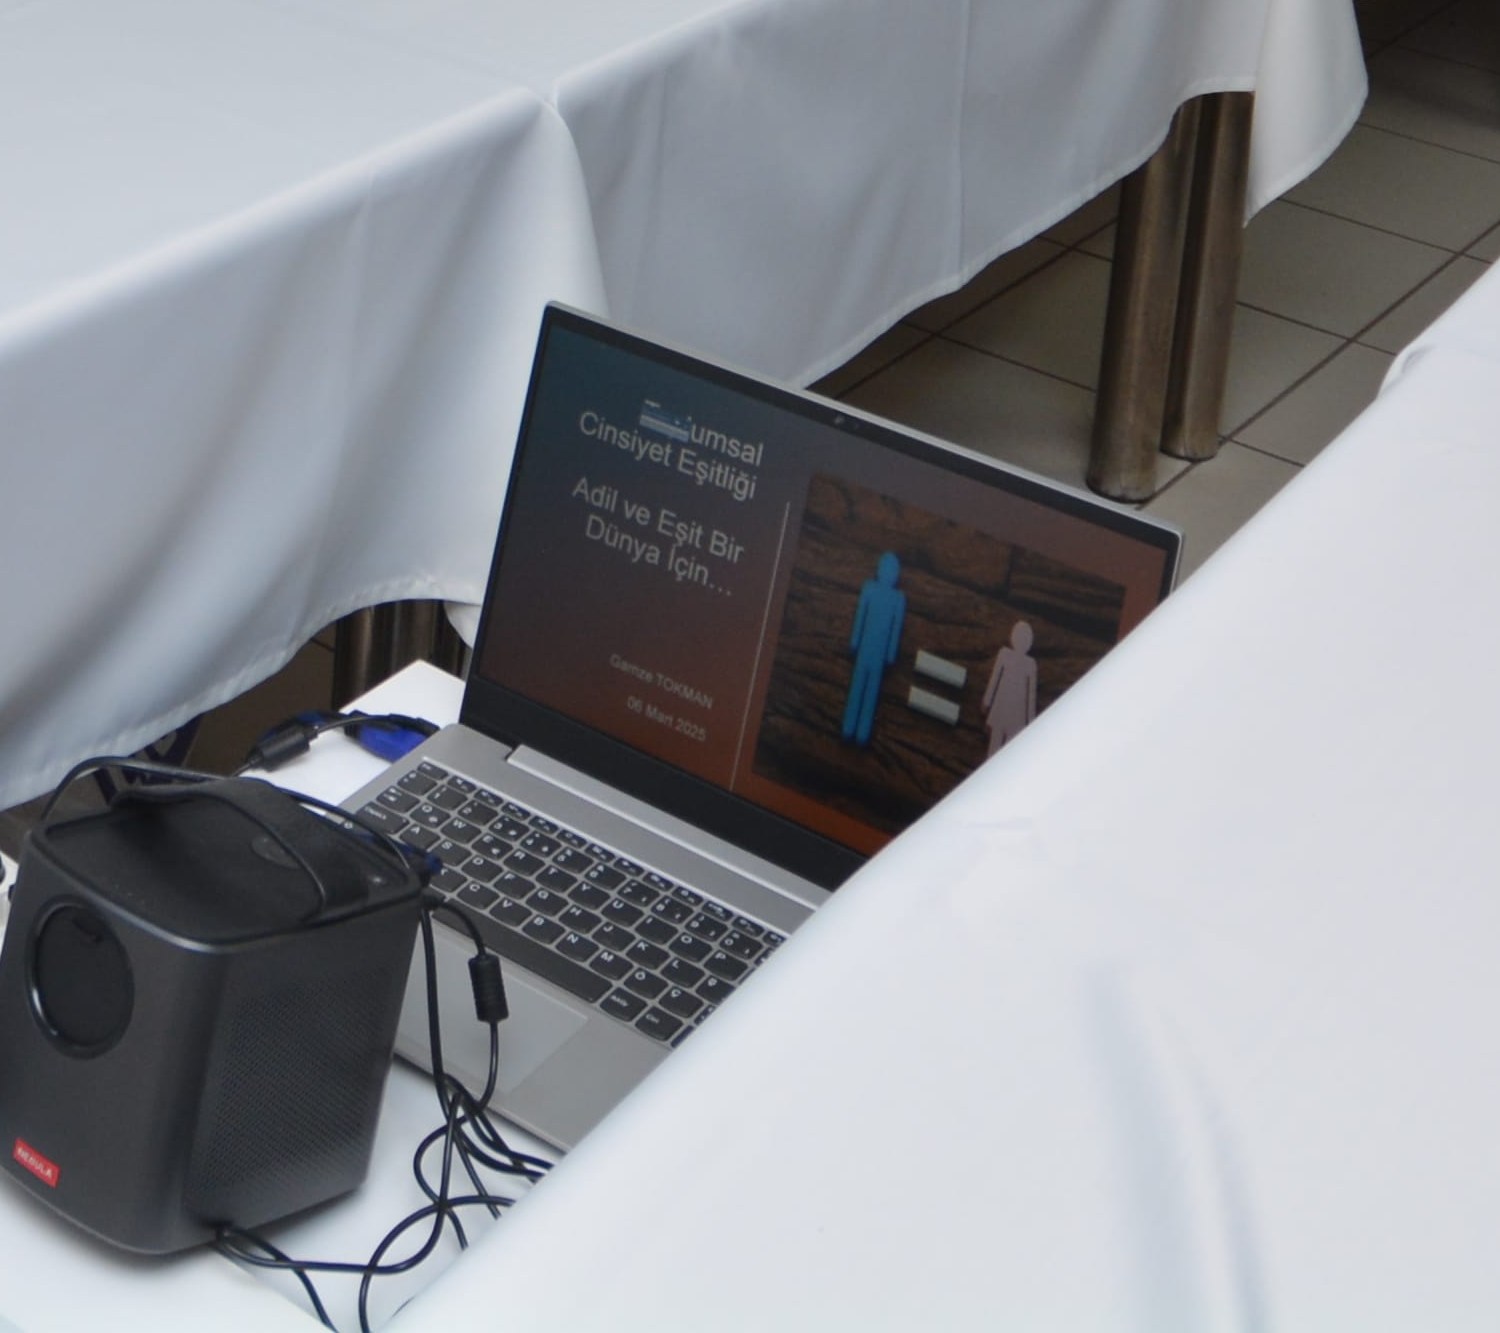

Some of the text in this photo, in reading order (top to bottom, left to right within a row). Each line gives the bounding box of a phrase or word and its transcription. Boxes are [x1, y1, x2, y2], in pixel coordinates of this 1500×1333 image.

[580, 411, 757, 502] Cinsiyet Eşitliği
[572, 477, 744, 563] Adil ve Eşit Bir
[585, 514, 661, 566] Dünya
